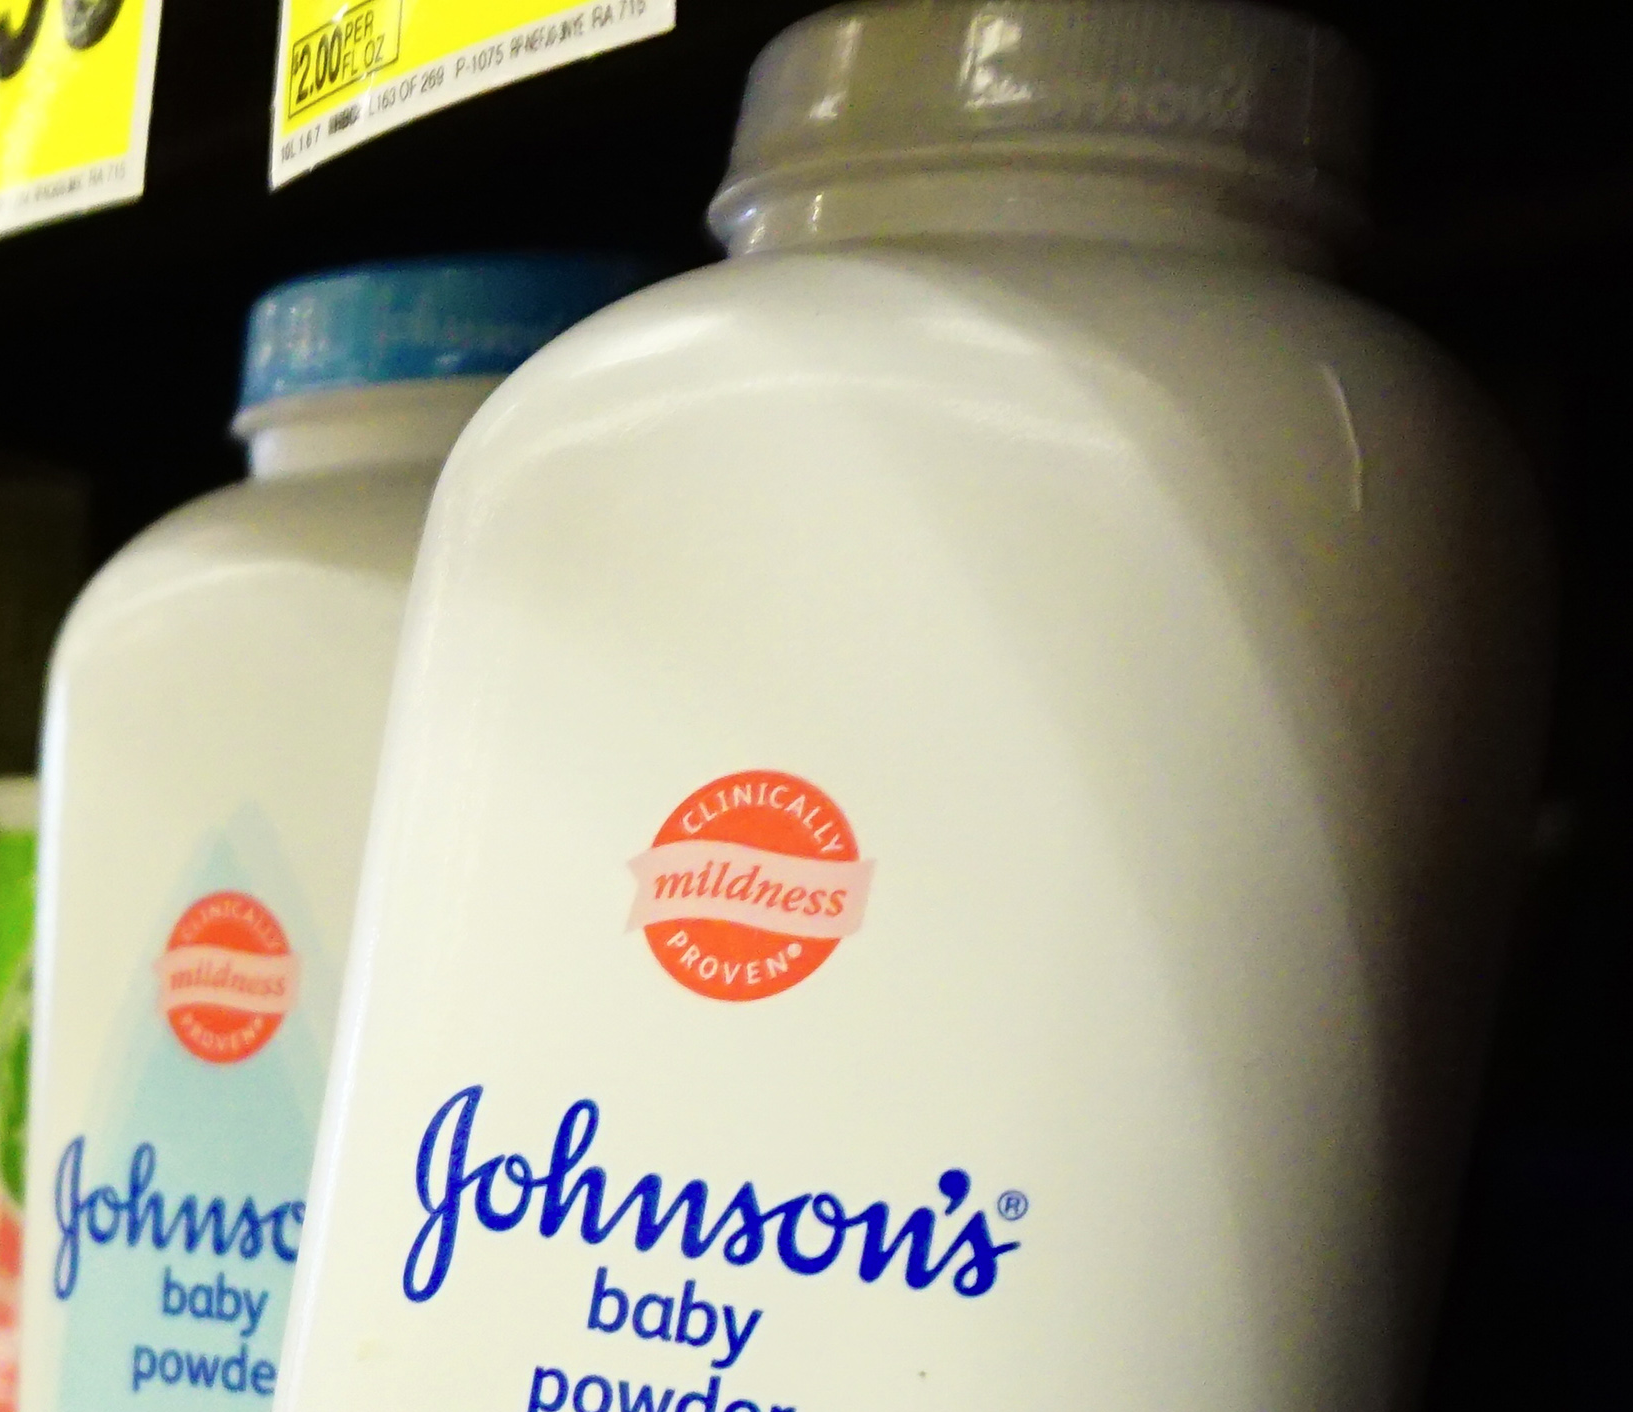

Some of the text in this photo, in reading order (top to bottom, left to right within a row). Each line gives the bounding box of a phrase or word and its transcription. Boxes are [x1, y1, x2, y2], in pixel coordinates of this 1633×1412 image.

[344, 10, 375, 46] PER
[342, 33, 386, 80] FL OZ
[399, 75, 418, 102] OF
[681, 782, 845, 854] CLINICALLY
[653, 860, 848, 917] mildness
[169, 957, 286, 997] mildness
[54, 1134, 307, 1301] Johnso
[161, 1265, 270, 1339] baby
[586, 1266, 764, 1369] baby
[131, 1343, 278, 1396] powde
